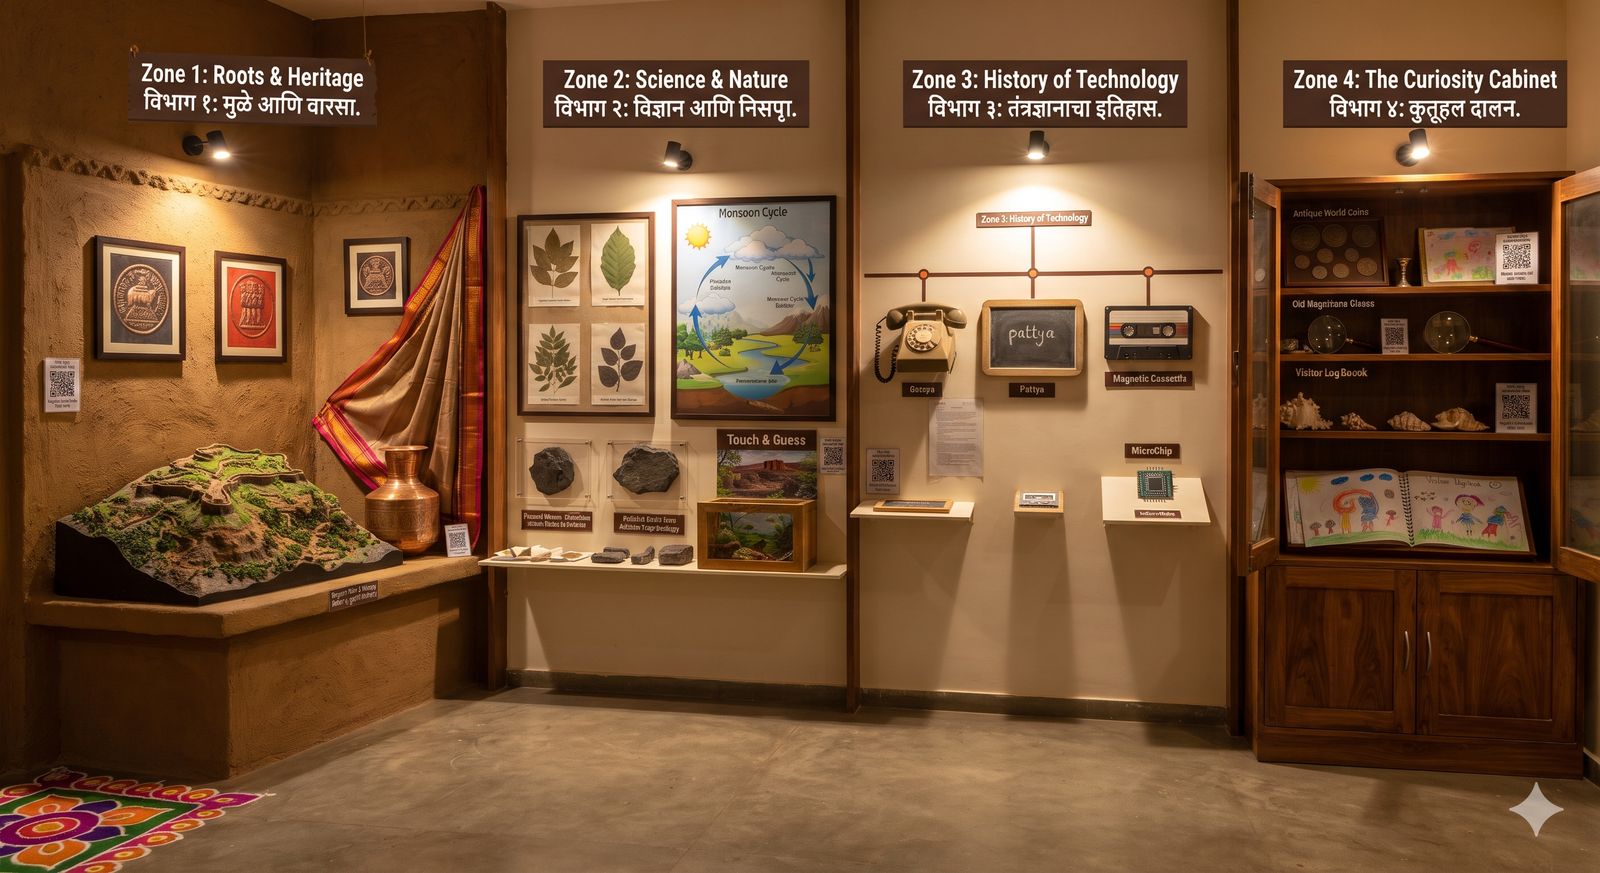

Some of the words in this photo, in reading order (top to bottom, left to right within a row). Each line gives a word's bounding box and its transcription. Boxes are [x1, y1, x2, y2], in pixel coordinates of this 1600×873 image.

[141, 62, 186, 84] Zone
[191, 64, 208, 84] 1:
[213, 64, 265, 86] Roots
[270, 66, 283, 87] &
[288, 66, 364, 92] Heritage
[563, 69, 608, 89] Zone
[613, 69, 631, 89] 2:
[635, 68, 706, 89] Science
[711, 69, 724, 89] &
[729, 69, 789, 89] Nature
[912, 69, 956, 89] Zone
[961, 69, 978, 89] 3:
[984, 68, 1048, 94] History
[1053, 68, 1072, 89] of
[1076, 68, 1179, 94] Technology
[1293, 69, 1338, 89] Zone
[1343, 69, 1361, 89] 4:
[1365, 68, 1399, 89] The
[1403, 68, 1484, 94] Curiosity
[1489, 68, 1558, 89] Cabinet
[143, 87, 197, 111] विभाग
[202, 94, 218, 114] १:
[222, 90, 253, 119] मुळे
[257, 90, 303, 114] आणि
[306, 97, 362, 117] वारसा.
[554, 93, 607, 118] विभाग
[612, 99, 629, 118] २:
[633, 93, 685, 119] विज्ञान
[689, 93, 735, 118] आणि
[928, 93, 981, 118] विभाग
[986, 100, 1002, 120] ३:
[1007, 94, 1091, 118] तंत्रज्ञानाचा
[1095, 94, 1163, 121] इतिहास.
[1329, 93, 1382, 118] विभाग
[1386, 99, 1405, 118] ४:
[1408, 99, 1466, 124] कुतूहल
[1469, 99, 1521, 118] दालन.
[718, 208, 760, 219] Monsoon
[762, 206, 788, 220] Cycle
[981, 214, 1000, 224] Zone
[1001, 214, 1008, 223] 3:
[1009, 213, 1036, 225] History
[1036, 213, 1045, 223] of
[1045, 212, 1088, 224] Technology
[1293, 208, 1323, 219] Antique
[1323, 208, 1346, 217] World
[1347, 207, 1368, 217] Coins
[1292, 299, 1306, 308] Old
[1007, 326, 1055, 348] pattya
[1112, 373, 1149, 385] Magnetic
[1295, 367, 1323, 377] Visitor
[1324, 367, 1340, 379] Log
[1340, 367, 1368, 377] Boook
[1019, 385, 1045, 395] Pattya
[726, 433, 760, 446] Touch
[762, 433, 771, 446] &
[772, 433, 807, 447] Guess
[1131, 446, 1173, 456] MicroChip
